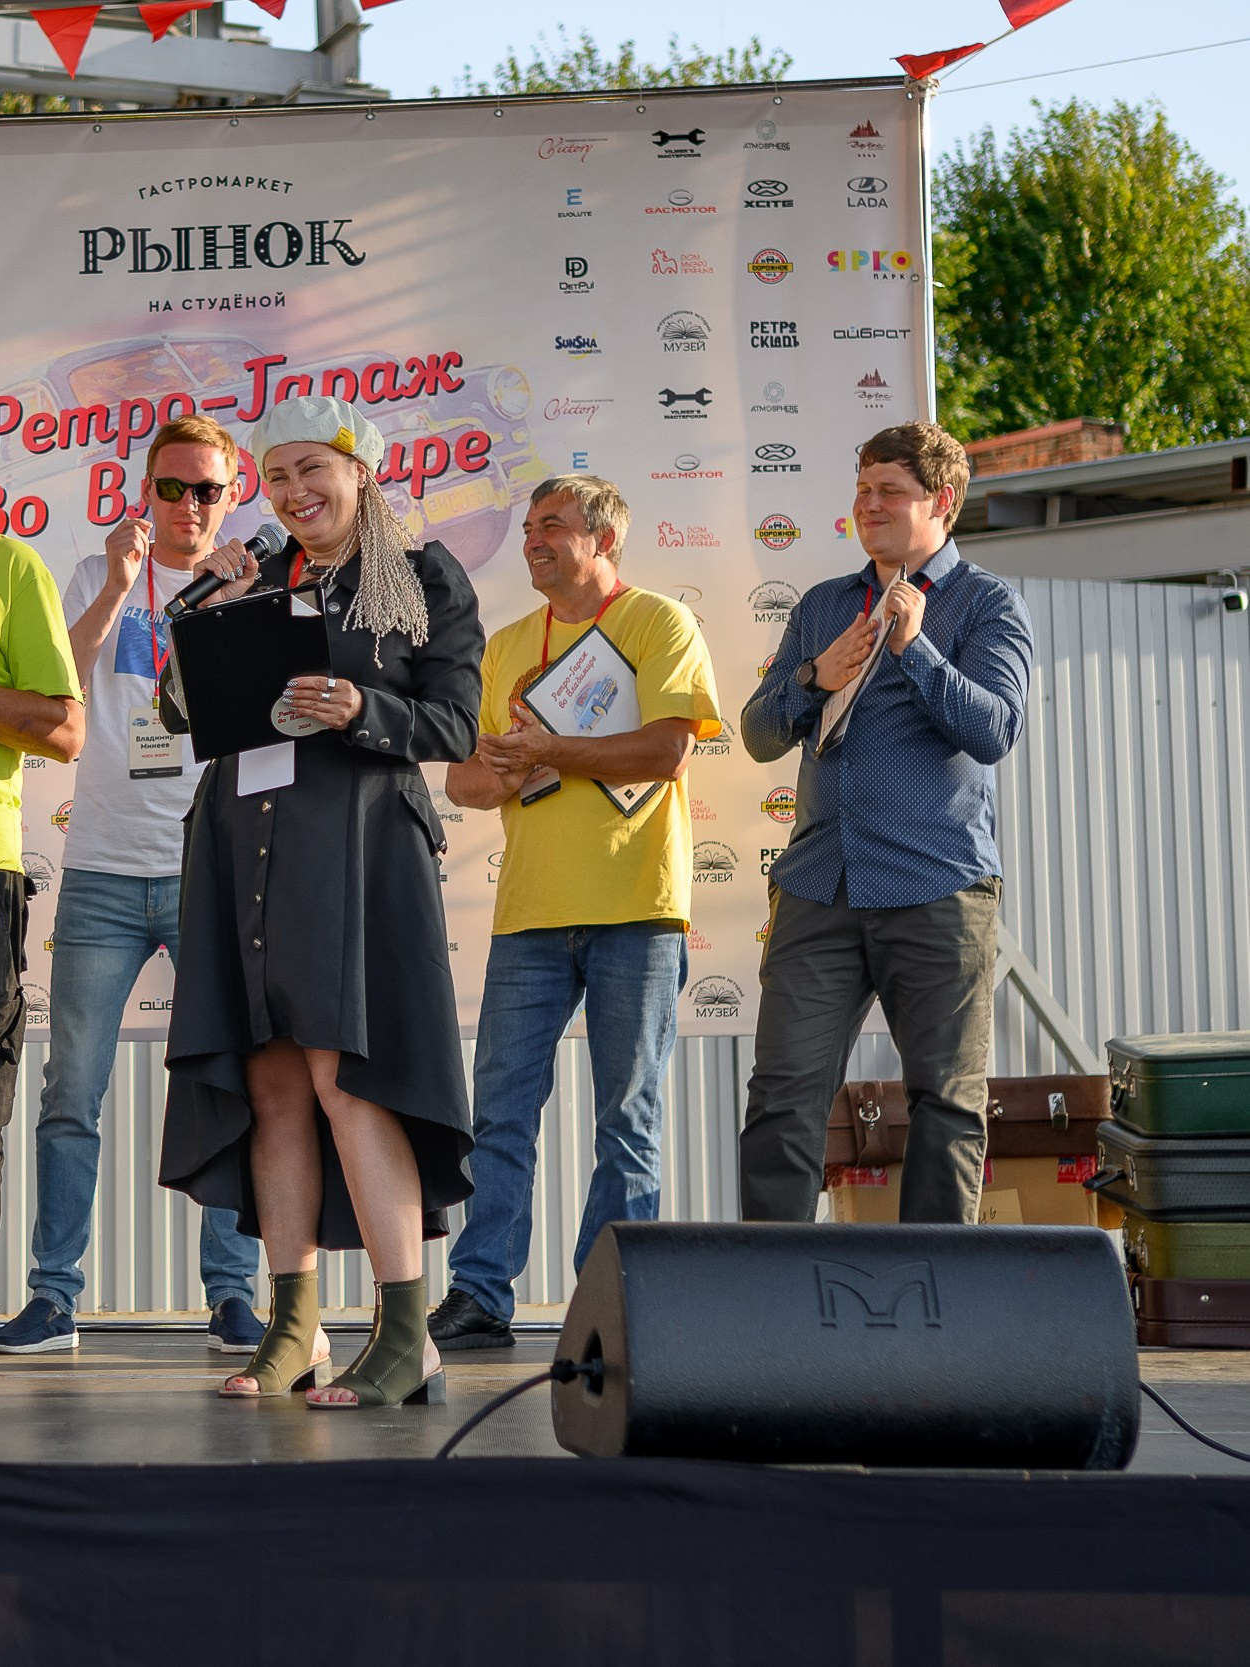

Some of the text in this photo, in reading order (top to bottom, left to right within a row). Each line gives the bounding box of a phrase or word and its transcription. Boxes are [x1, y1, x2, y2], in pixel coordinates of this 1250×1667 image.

[538, 137, 594, 163] Victory
[138, 174, 294, 199] ГАСТРОМАРКЕТ
[744, 200, 794, 209] XCITE
[847, 197, 889, 209] LADA
[78, 218, 366, 275] РЫНОК
[827, 250, 912, 273] ЯРКО
[149, 291, 287, 312] НА СТУДЁНОЙ
[750, 321, 797, 334] РЕТРО
[664, 341, 706, 352] МУЗЕЙ
[544, 397, 600, 425] Victory
[751, 464, 802, 473] XCITE
[24, 757, 46, 769] ЗЕЙ
[692, 871, 733, 883] МУЗЕЙ
[27, 1010, 49, 1024] ЗЕЙ
[696, 1005, 739, 1018] МУЗЕЙ
